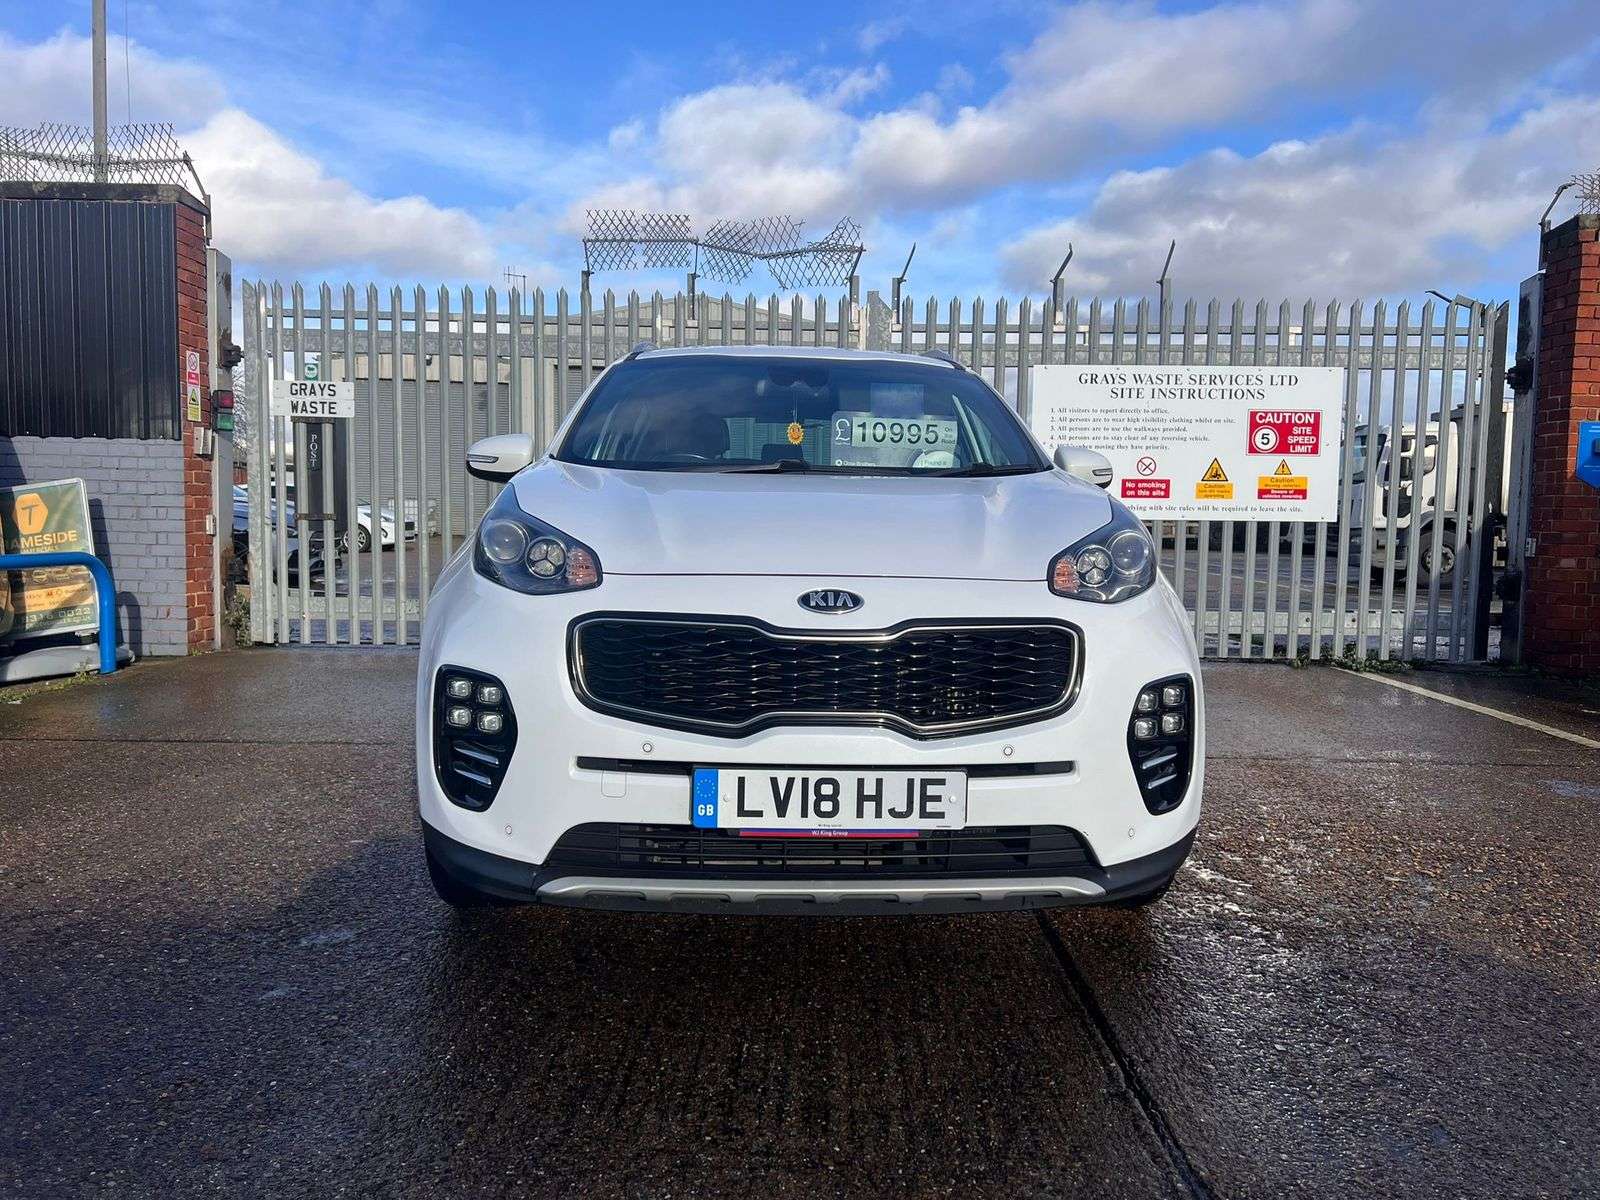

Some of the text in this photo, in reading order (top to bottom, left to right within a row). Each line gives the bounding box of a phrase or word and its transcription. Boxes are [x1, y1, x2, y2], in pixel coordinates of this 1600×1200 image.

[1078, 373, 1298, 386] GRAYS WASTE SERVICES LTD
[290, 383, 336, 397] GRAYS
[1110, 387, 1265, 400] SITE INSTRUCTIONS
[291, 401, 337, 414] WASTE
[1256, 412, 1315, 424] CAUTION
[857, 422, 939, 445] 10995
[1292, 426, 1312, 435] SITE
[1261, 433, 1270, 446] 5
[1288, 436, 1317, 444] SPEED
[310, 434, 318, 467] POST
[1290, 445, 1313, 453] LIMIT
[1138, 482, 1166, 490] smoking
[22, 504, 39, 526] T
[810, 592, 854, 607] KIA
[736, 776, 946, 820] LV18 HJE
[697, 804, 714, 817] GB
[820, 830, 832, 838] King
[833, 830, 848, 838] Group
